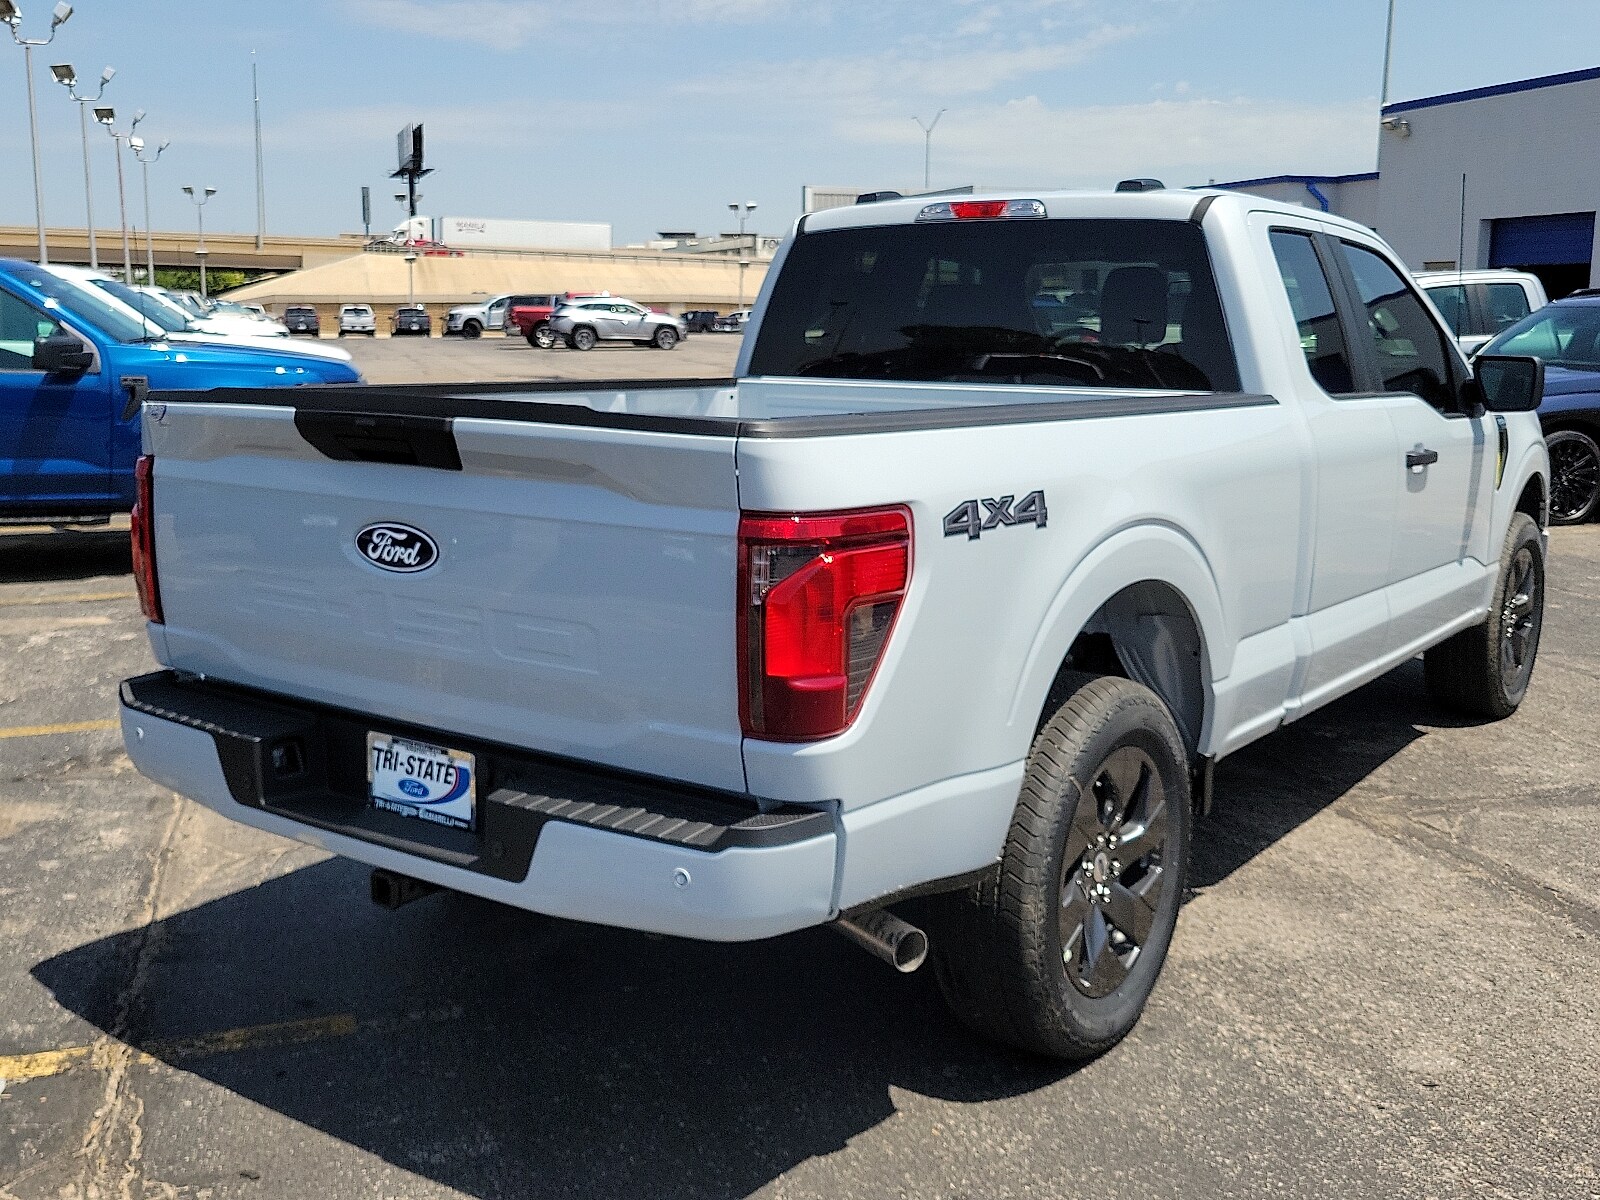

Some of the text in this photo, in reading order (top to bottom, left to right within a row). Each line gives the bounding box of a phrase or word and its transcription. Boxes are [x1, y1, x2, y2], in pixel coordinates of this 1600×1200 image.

[367, 528, 422, 566] Ford
[372, 746, 456, 785] TRI-STATE
[404, 781, 425, 795] Ford
